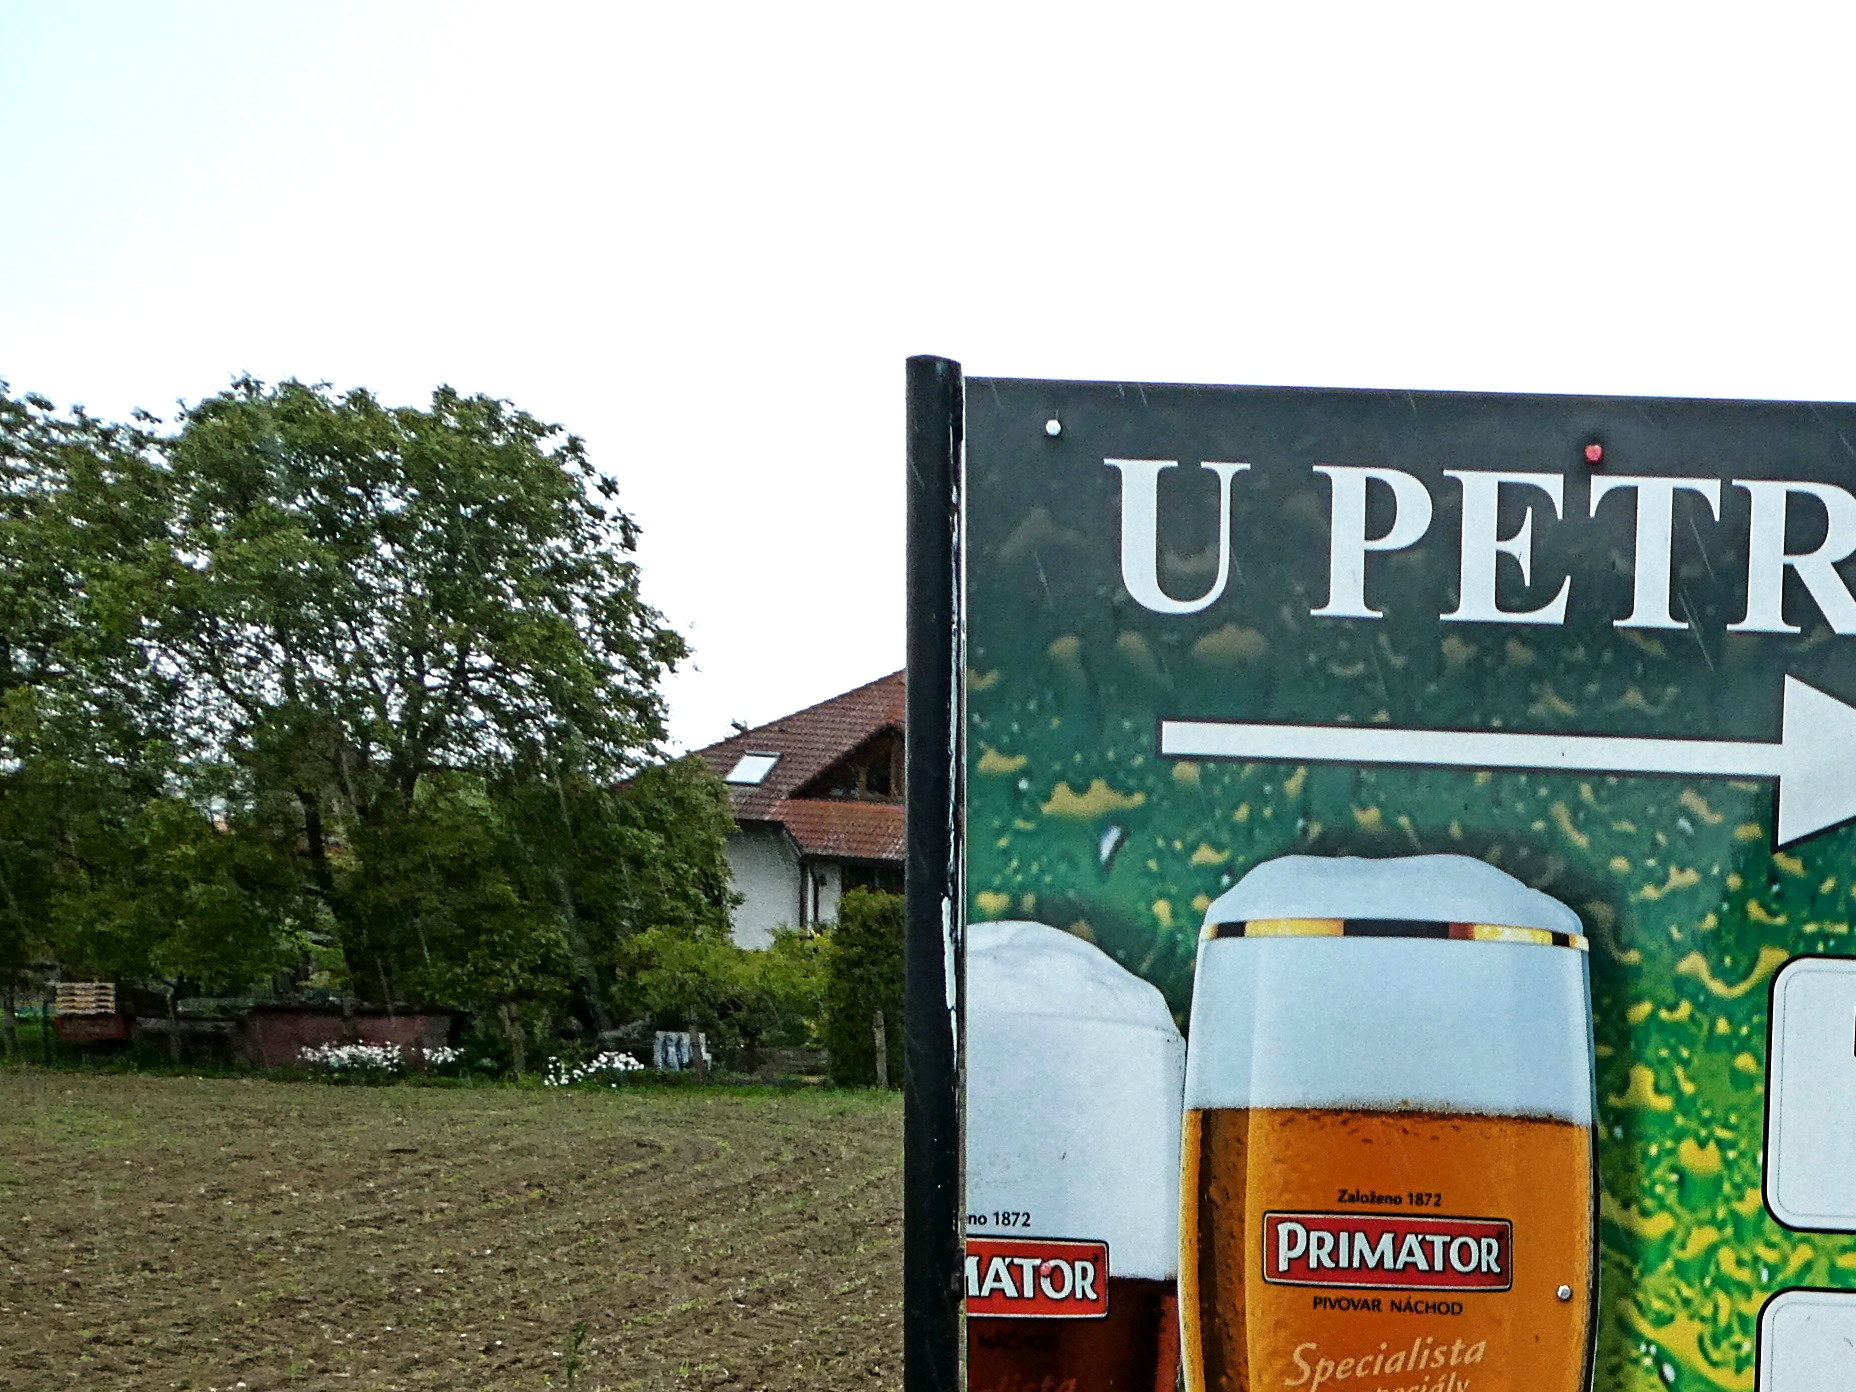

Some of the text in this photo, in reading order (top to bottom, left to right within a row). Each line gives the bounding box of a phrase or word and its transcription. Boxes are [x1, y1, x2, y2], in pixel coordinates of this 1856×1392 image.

[1103, 458, 1251, 615] U
[1337, 1189, 1442, 1207] Založeno 1872
[993, 1211, 1031, 1228] 1872
[1313, 1295, 1463, 1315] PIVOVAR NÁCHOD
